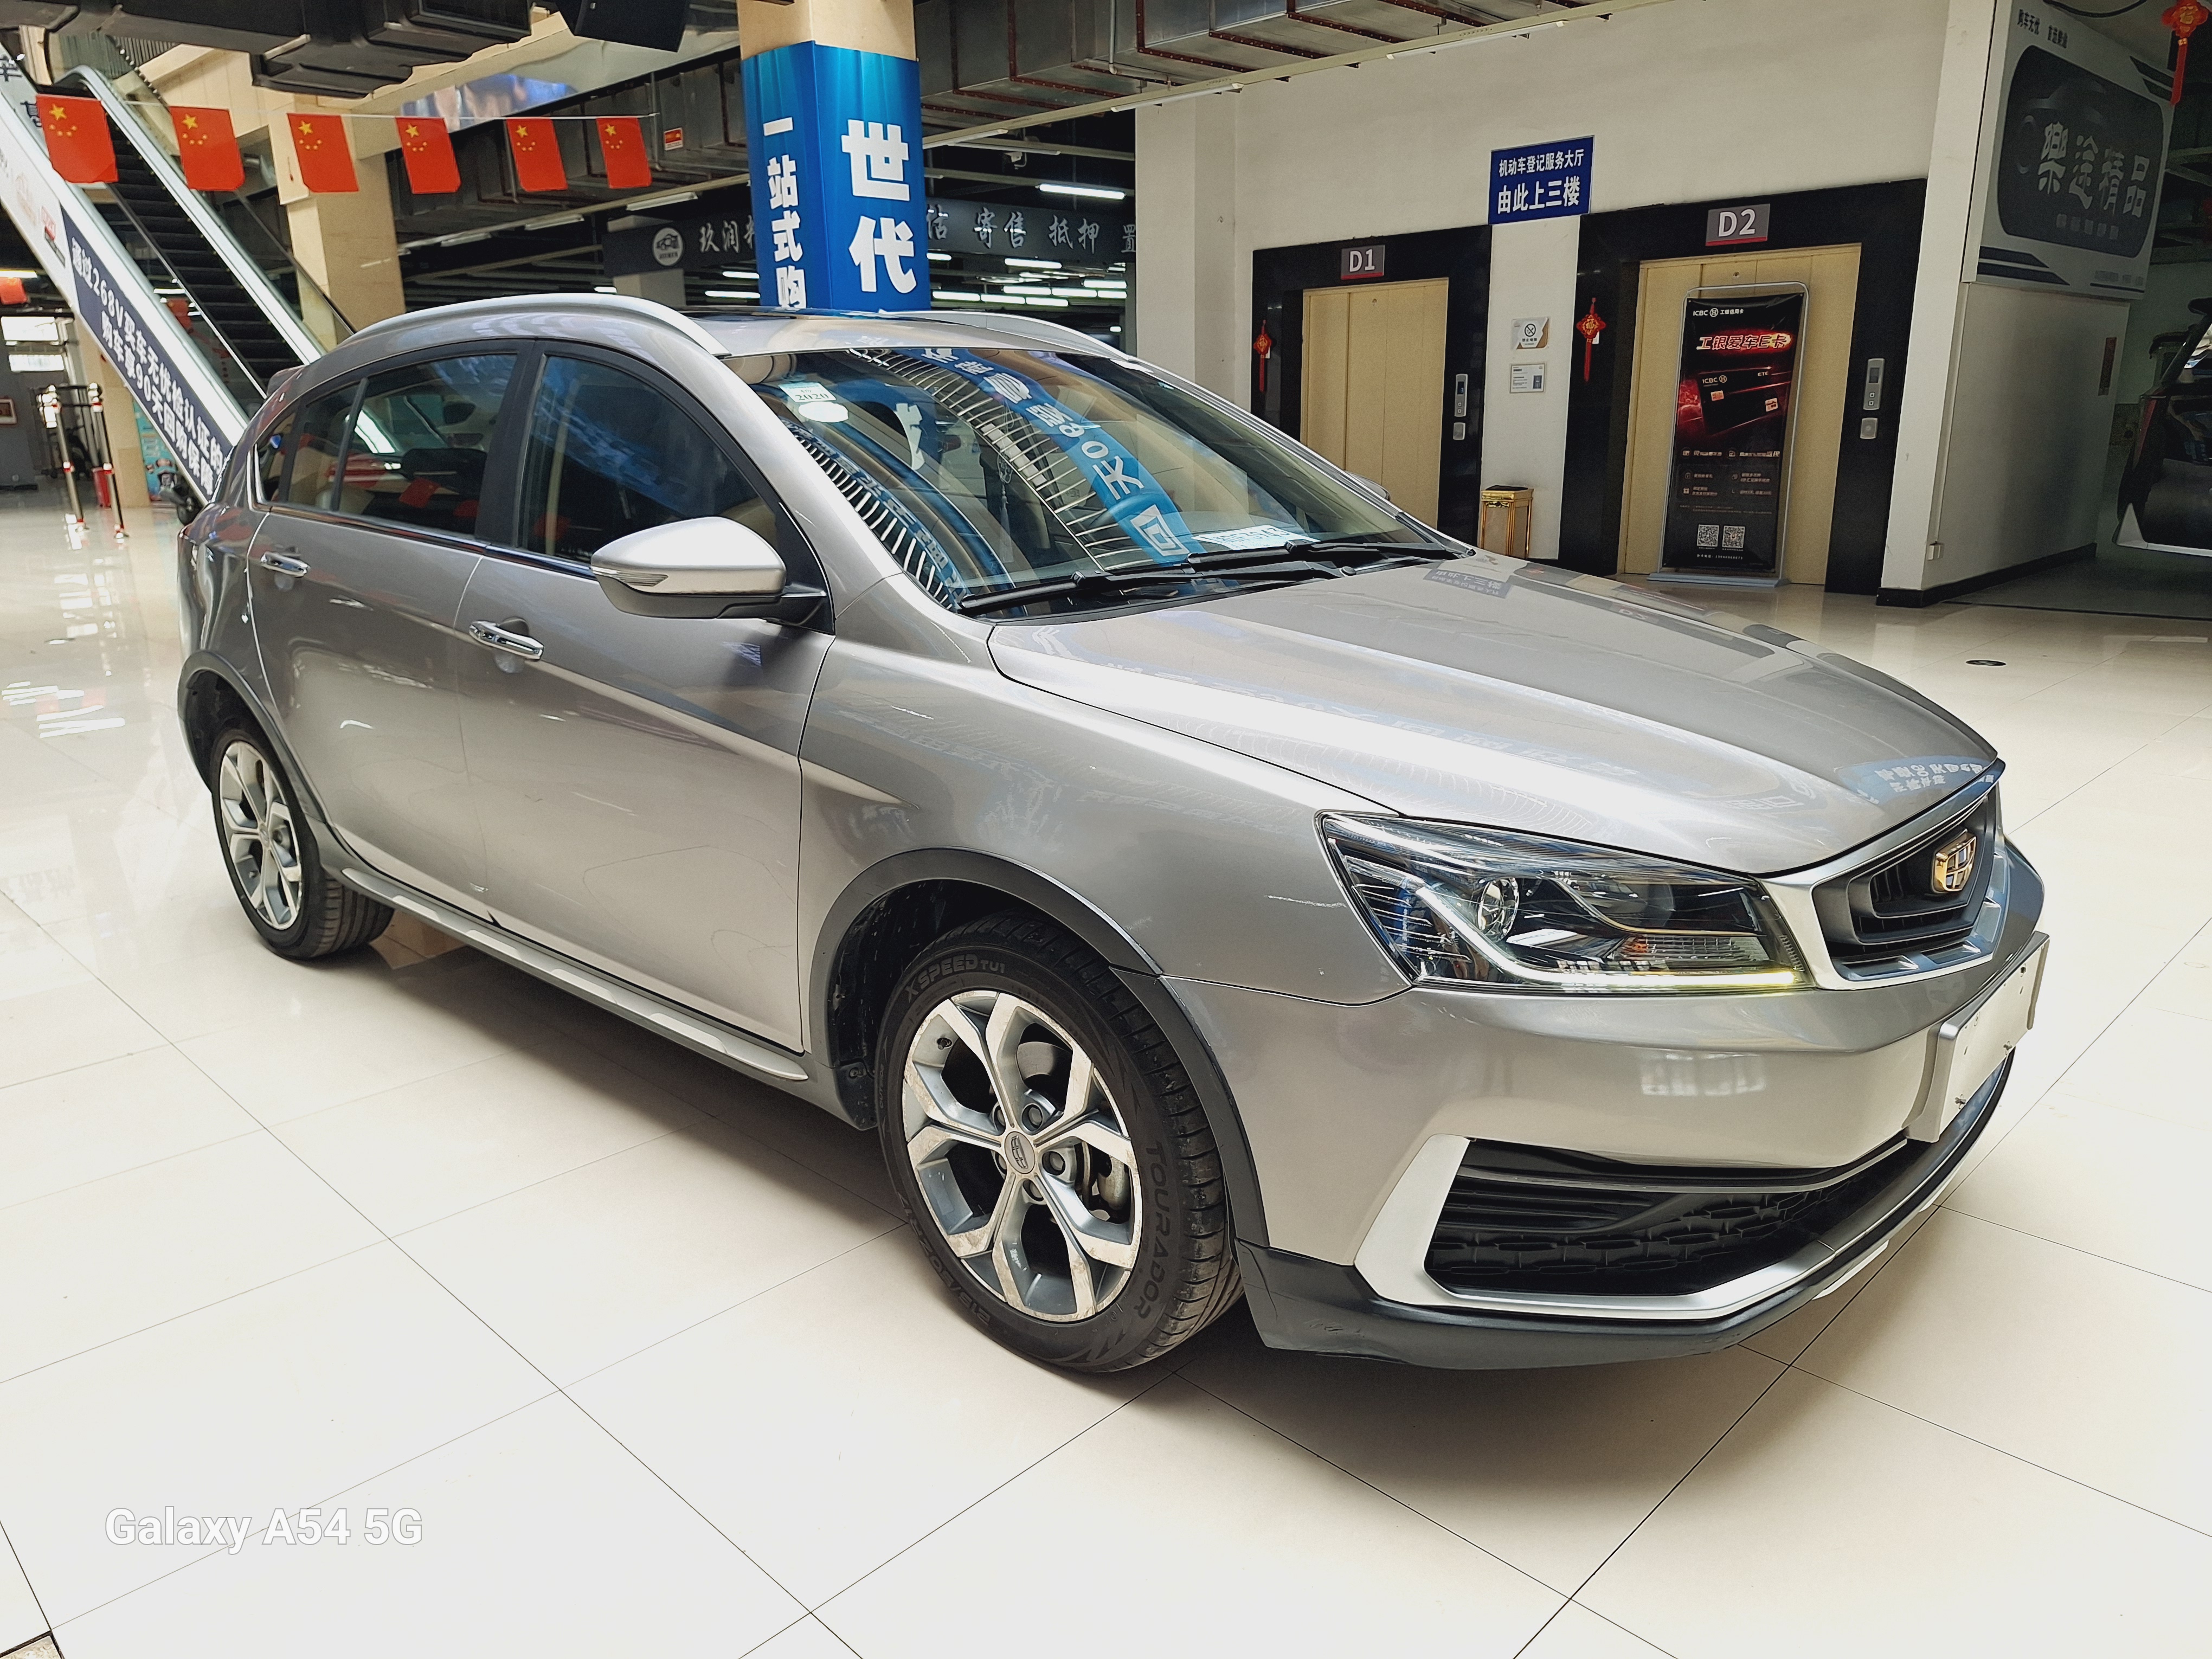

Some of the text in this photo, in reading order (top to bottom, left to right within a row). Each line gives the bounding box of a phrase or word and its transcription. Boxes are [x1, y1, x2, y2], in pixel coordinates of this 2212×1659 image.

[1499, 149, 1584, 177] 机动车登记服务大厅
[763, 117, 807, 309] 一站式购
[841, 119, 917, 293] 世代
[1498, 176, 1580, 214] 由此上三楼
[974, 207, 1026, 249] 寄售
[1049, 215, 1100, 254] 抵押
[1121, 224, 1136, 253] 置
[1718, 209, 1756, 237] D2
[1349, 248, 1375, 272] D1
[1696, 333, 1787, 350] 工银爱车E卡
[918, 954, 978, 989] SPEED
[980, 960, 1006, 974] TU1
[1134, 1141, 1170, 1319] TOURADOR
